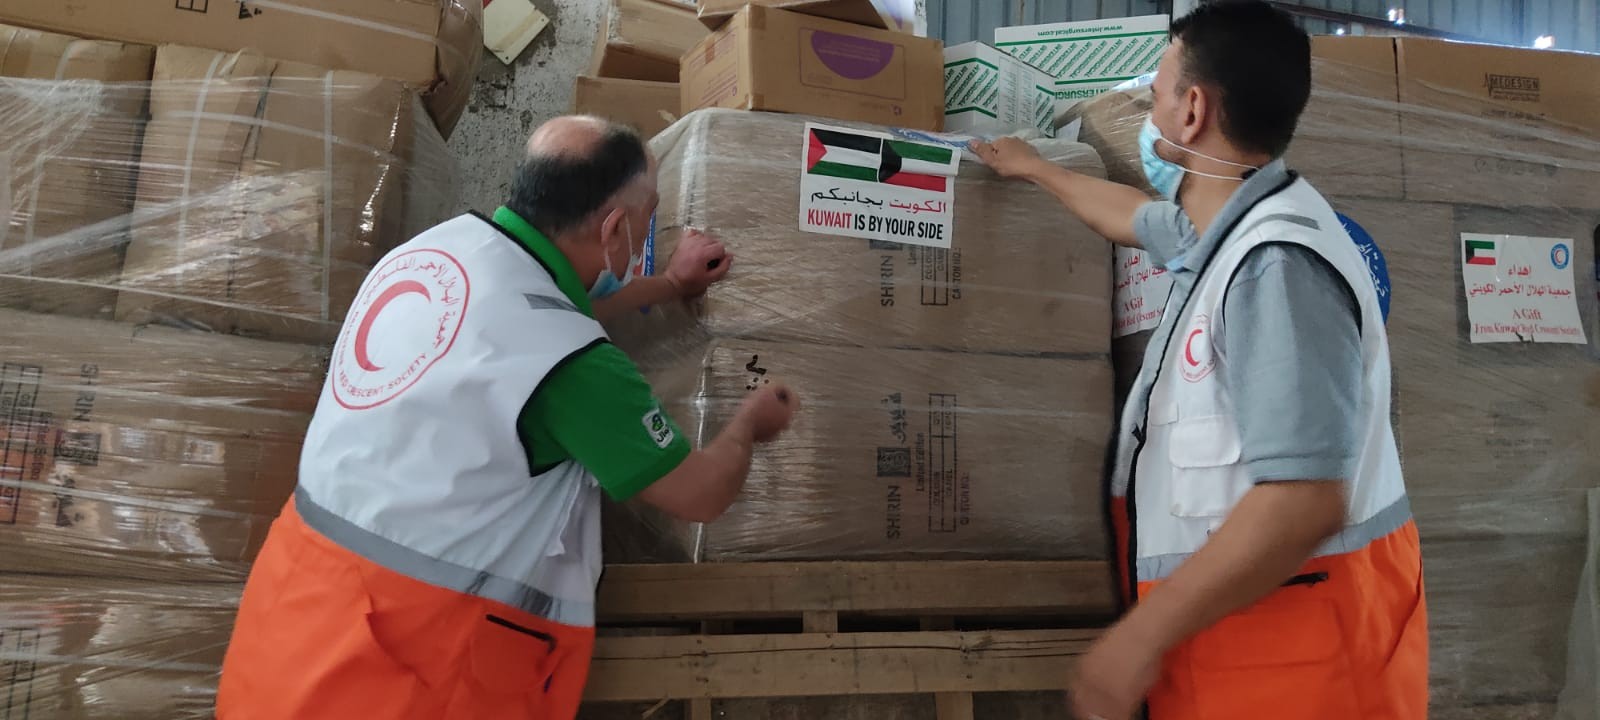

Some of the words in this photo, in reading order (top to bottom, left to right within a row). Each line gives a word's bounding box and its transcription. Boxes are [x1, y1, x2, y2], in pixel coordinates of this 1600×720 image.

[811, 187, 884, 210] بجانبكم
[889, 198, 946, 214] الكويت
[807, 208, 852, 229] KUWAIT
[854, 214, 866, 231] IS
[868, 215, 885, 233] BY
[886, 217, 915, 237] YOUR
[917, 221, 944, 240] SIDE
[880, 255, 895, 307] SHIRIN
[952, 264, 962, 300] CATON
[1526, 284, 1547, 297] الهلال
[1548, 284, 1571, 298] جمعية
[1512, 309, 1521, 320] A
[1522, 307, 1543, 320] Gift
[387, 352, 428, 390] SOCIETY
[887, 485, 901, 540] SHIRIN
